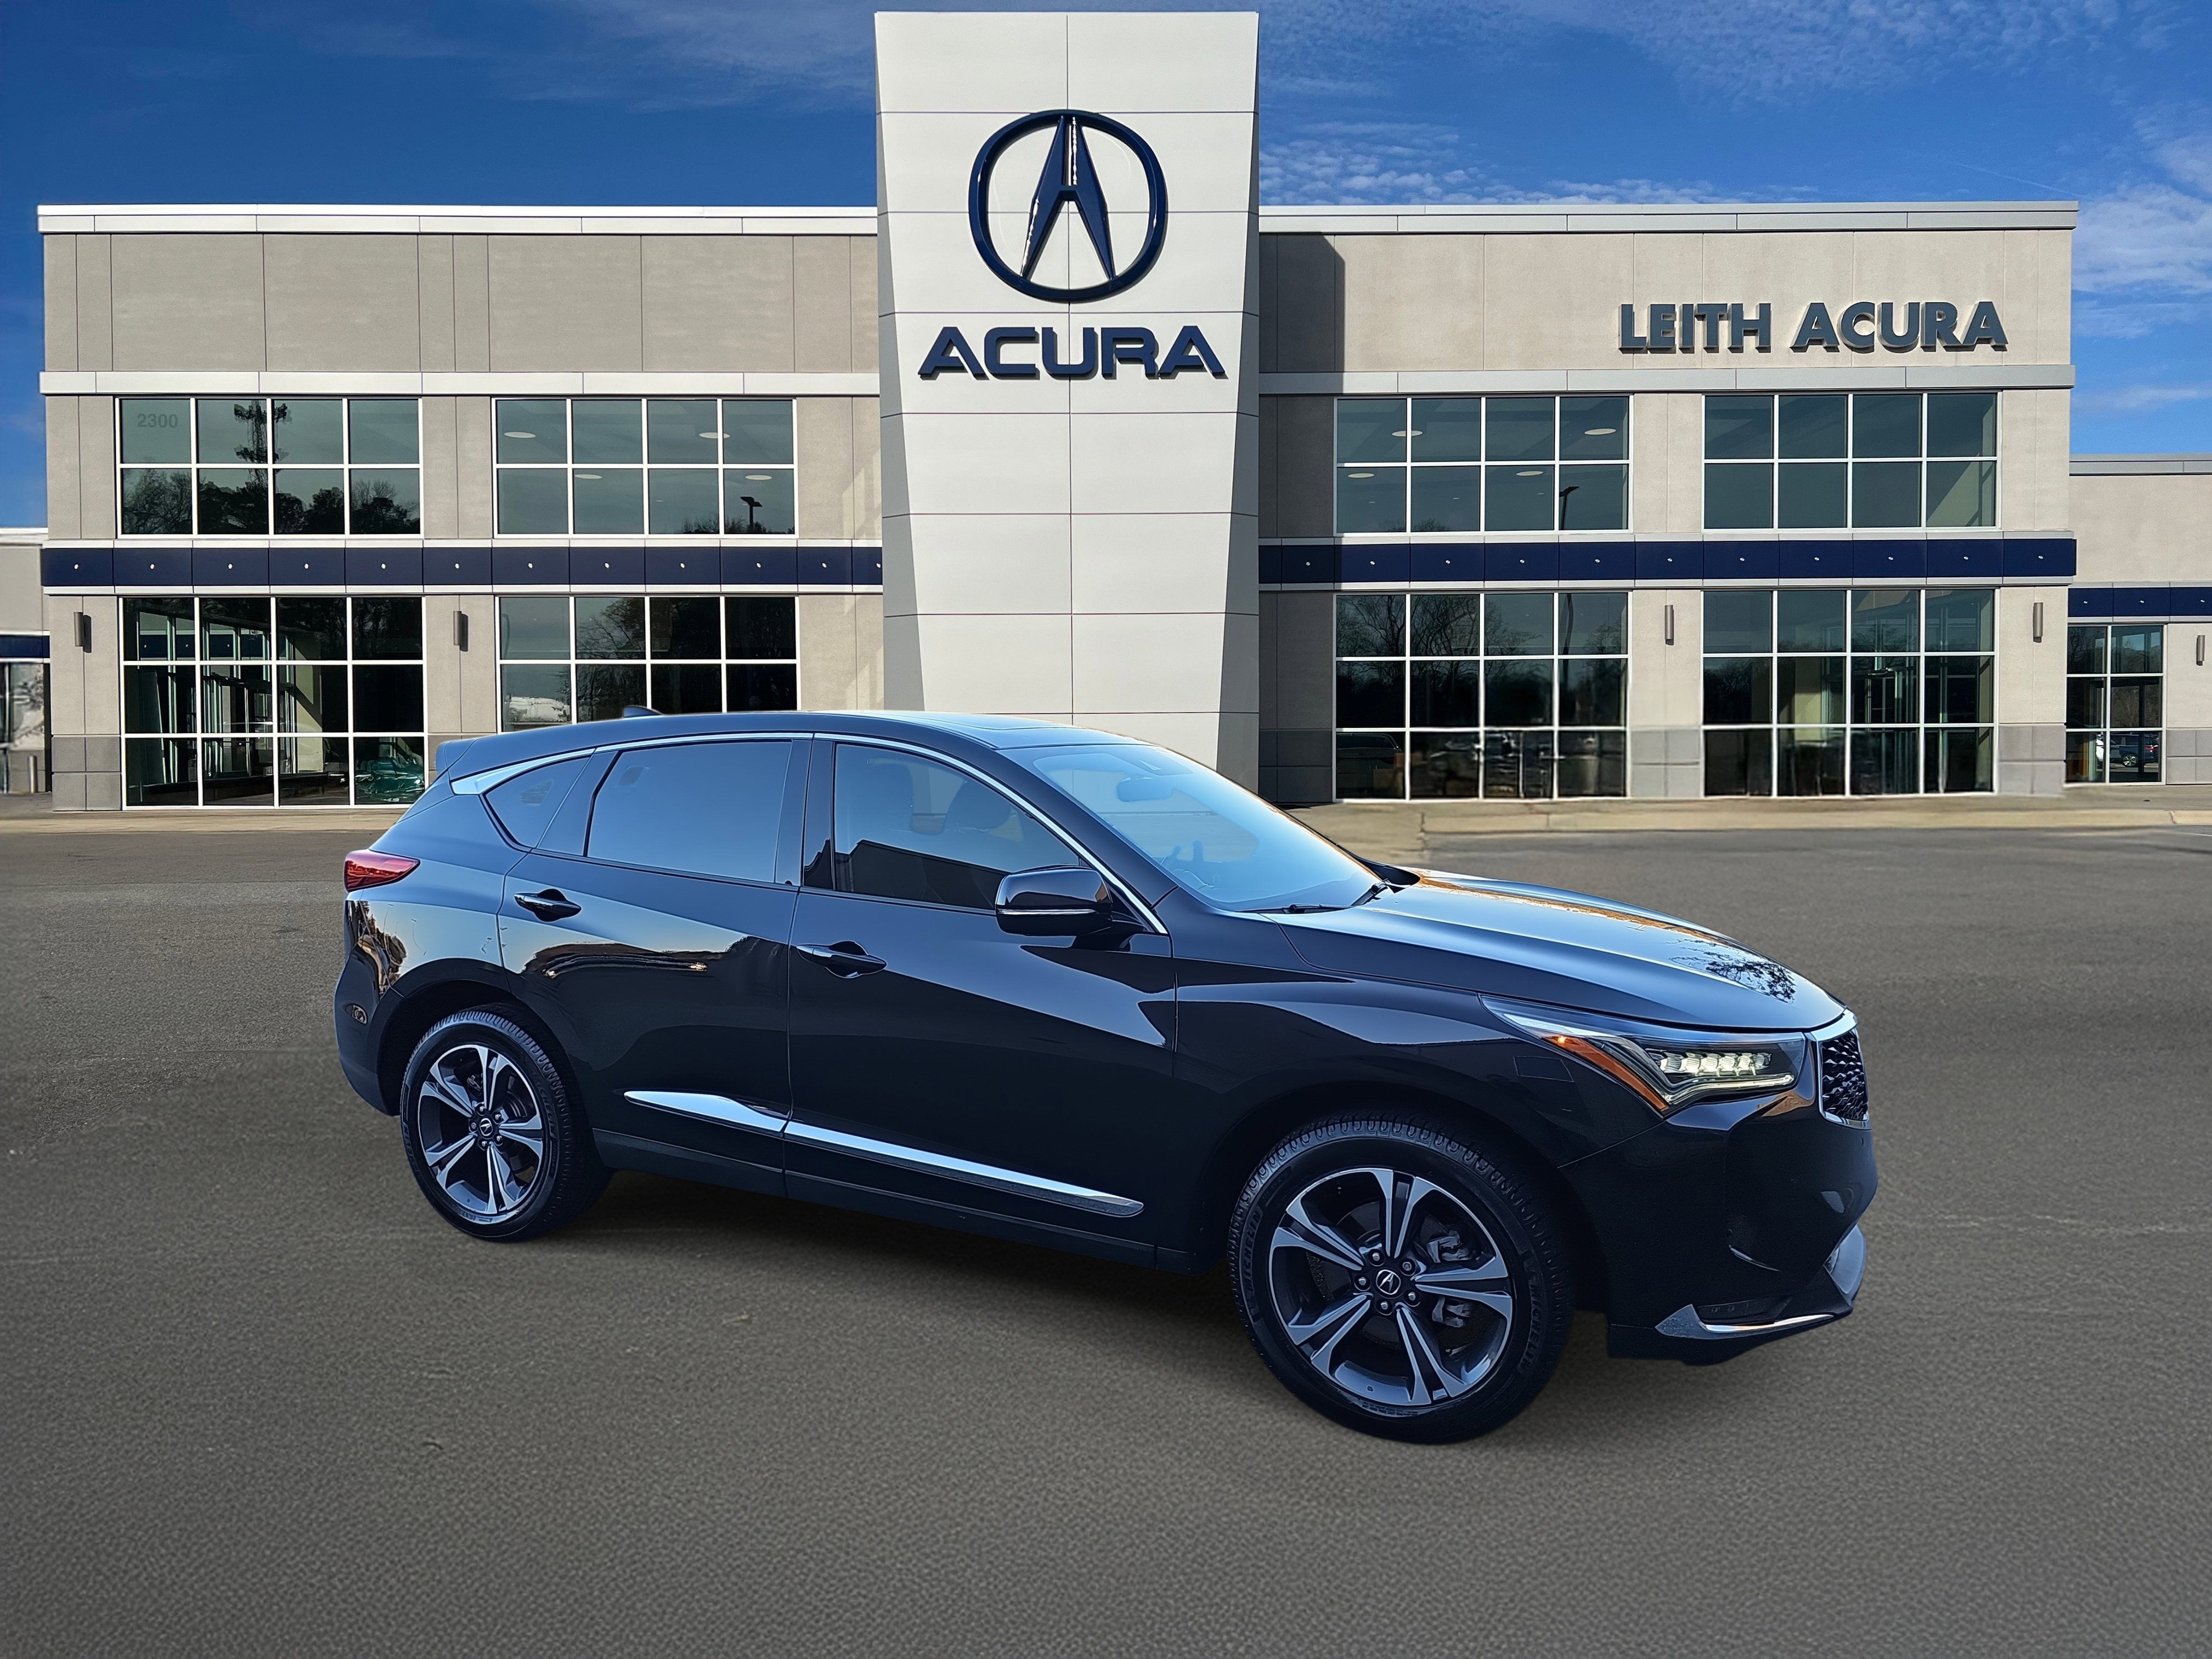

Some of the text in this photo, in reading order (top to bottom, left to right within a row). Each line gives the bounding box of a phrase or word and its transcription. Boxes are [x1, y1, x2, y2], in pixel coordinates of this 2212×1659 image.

[918, 325, 1228, 379] ACURA
[1619, 301, 2008, 353] LEITH ACURA
[137, 414, 178, 428] 2300
